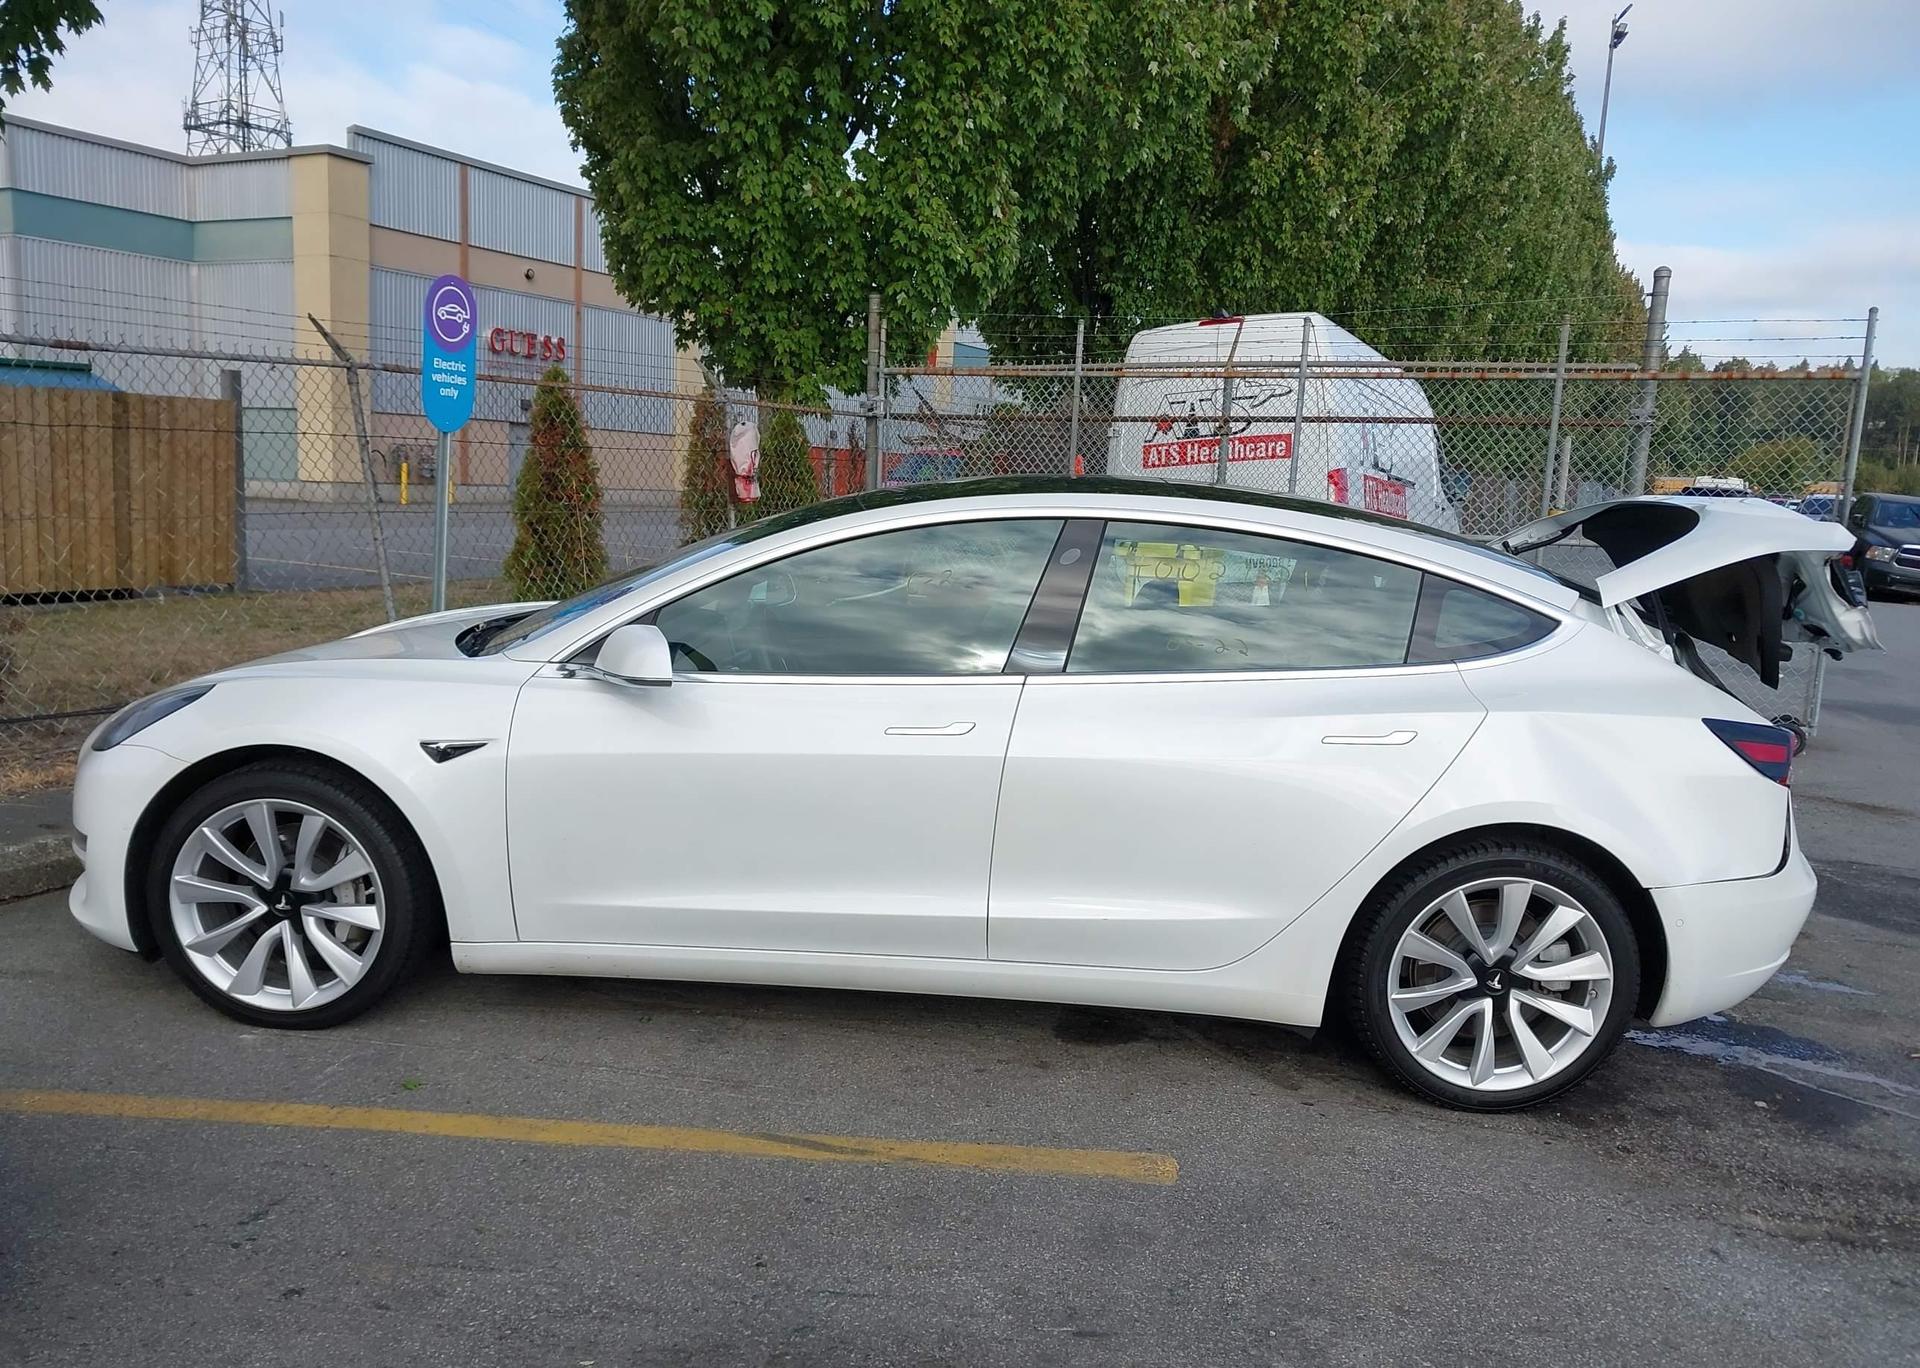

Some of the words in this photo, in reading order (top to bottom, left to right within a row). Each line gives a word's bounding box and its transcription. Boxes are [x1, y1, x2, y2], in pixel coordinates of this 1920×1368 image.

[490, 327, 566, 361] GUESS
[433, 357, 467, 372] Electric
[432, 372, 467, 386] vehicles
[440, 387, 459, 400] only
[1147, 443, 1180, 466] ATS
[1186, 439, 1287, 464] Heathcare
